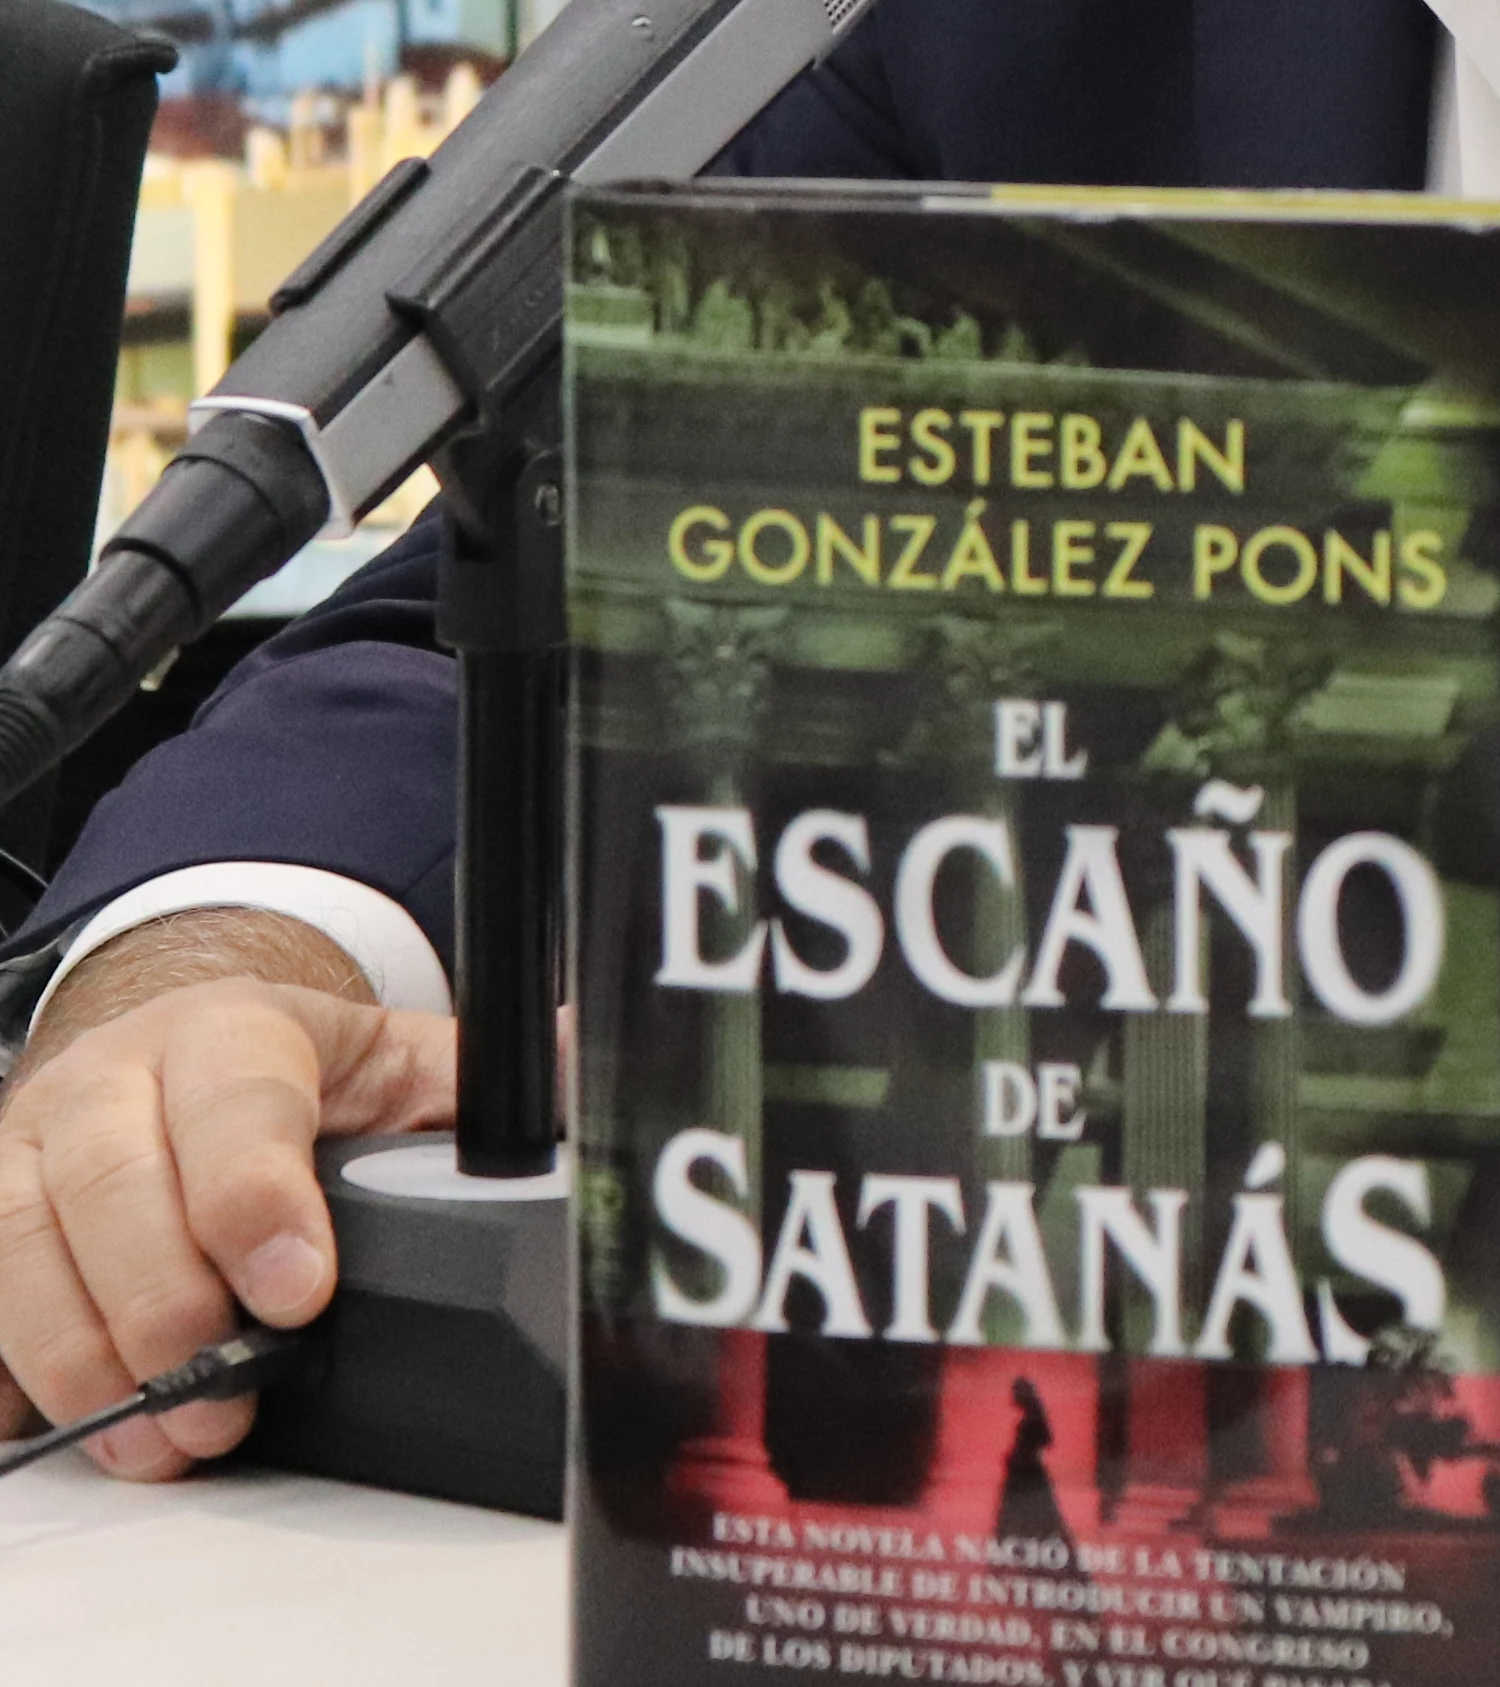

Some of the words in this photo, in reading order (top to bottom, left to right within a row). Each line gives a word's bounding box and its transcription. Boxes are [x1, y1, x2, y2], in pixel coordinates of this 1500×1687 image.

[858, 405, 1246, 494] ESTEBAN
[667, 498, 1155, 598] GONZÁLEZ
[1192, 524, 1448, 609] PONS
[993, 698, 1088, 781] EL
[654, 780, 1445, 1026] ESCAÑO
[983, 1061, 1086, 1140] DE
[652, 1127, 1446, 1365] SATANÁS
[670, 1546, 900, 1597] INSUPERABLE
[910, 1569, 958, 1601] DE
[967, 1575, 1200, 1615] INTRODUCIR
[1207, 1589, 1265, 1624] UN
[1273, 1596, 1454, 1640] VAMPIRO,
[712, 1511, 796, 1549] ESTA
[804, 1521, 946, 1561] NOVELA
[954, 1531, 1070, 1569] NACIÓ
[1075, 1541, 1125, 1575] DE
[1133, 1546, 1183, 1579] LA
[1191, 1548, 1406, 1592] TENTACIÓN
[708, 1629, 756, 1664] DE
[761, 1633, 832, 1670] LOS
[744, 1592, 826, 1631] UNO
[833, 1603, 882, 1636] DE
[888, 1607, 1042, 1651] VERDAD,
[1050, 1617, 1099, 1652] EN
[1108, 1623, 1156, 1656] EL
[1161, 1626, 1370, 1671] CONGRESO
